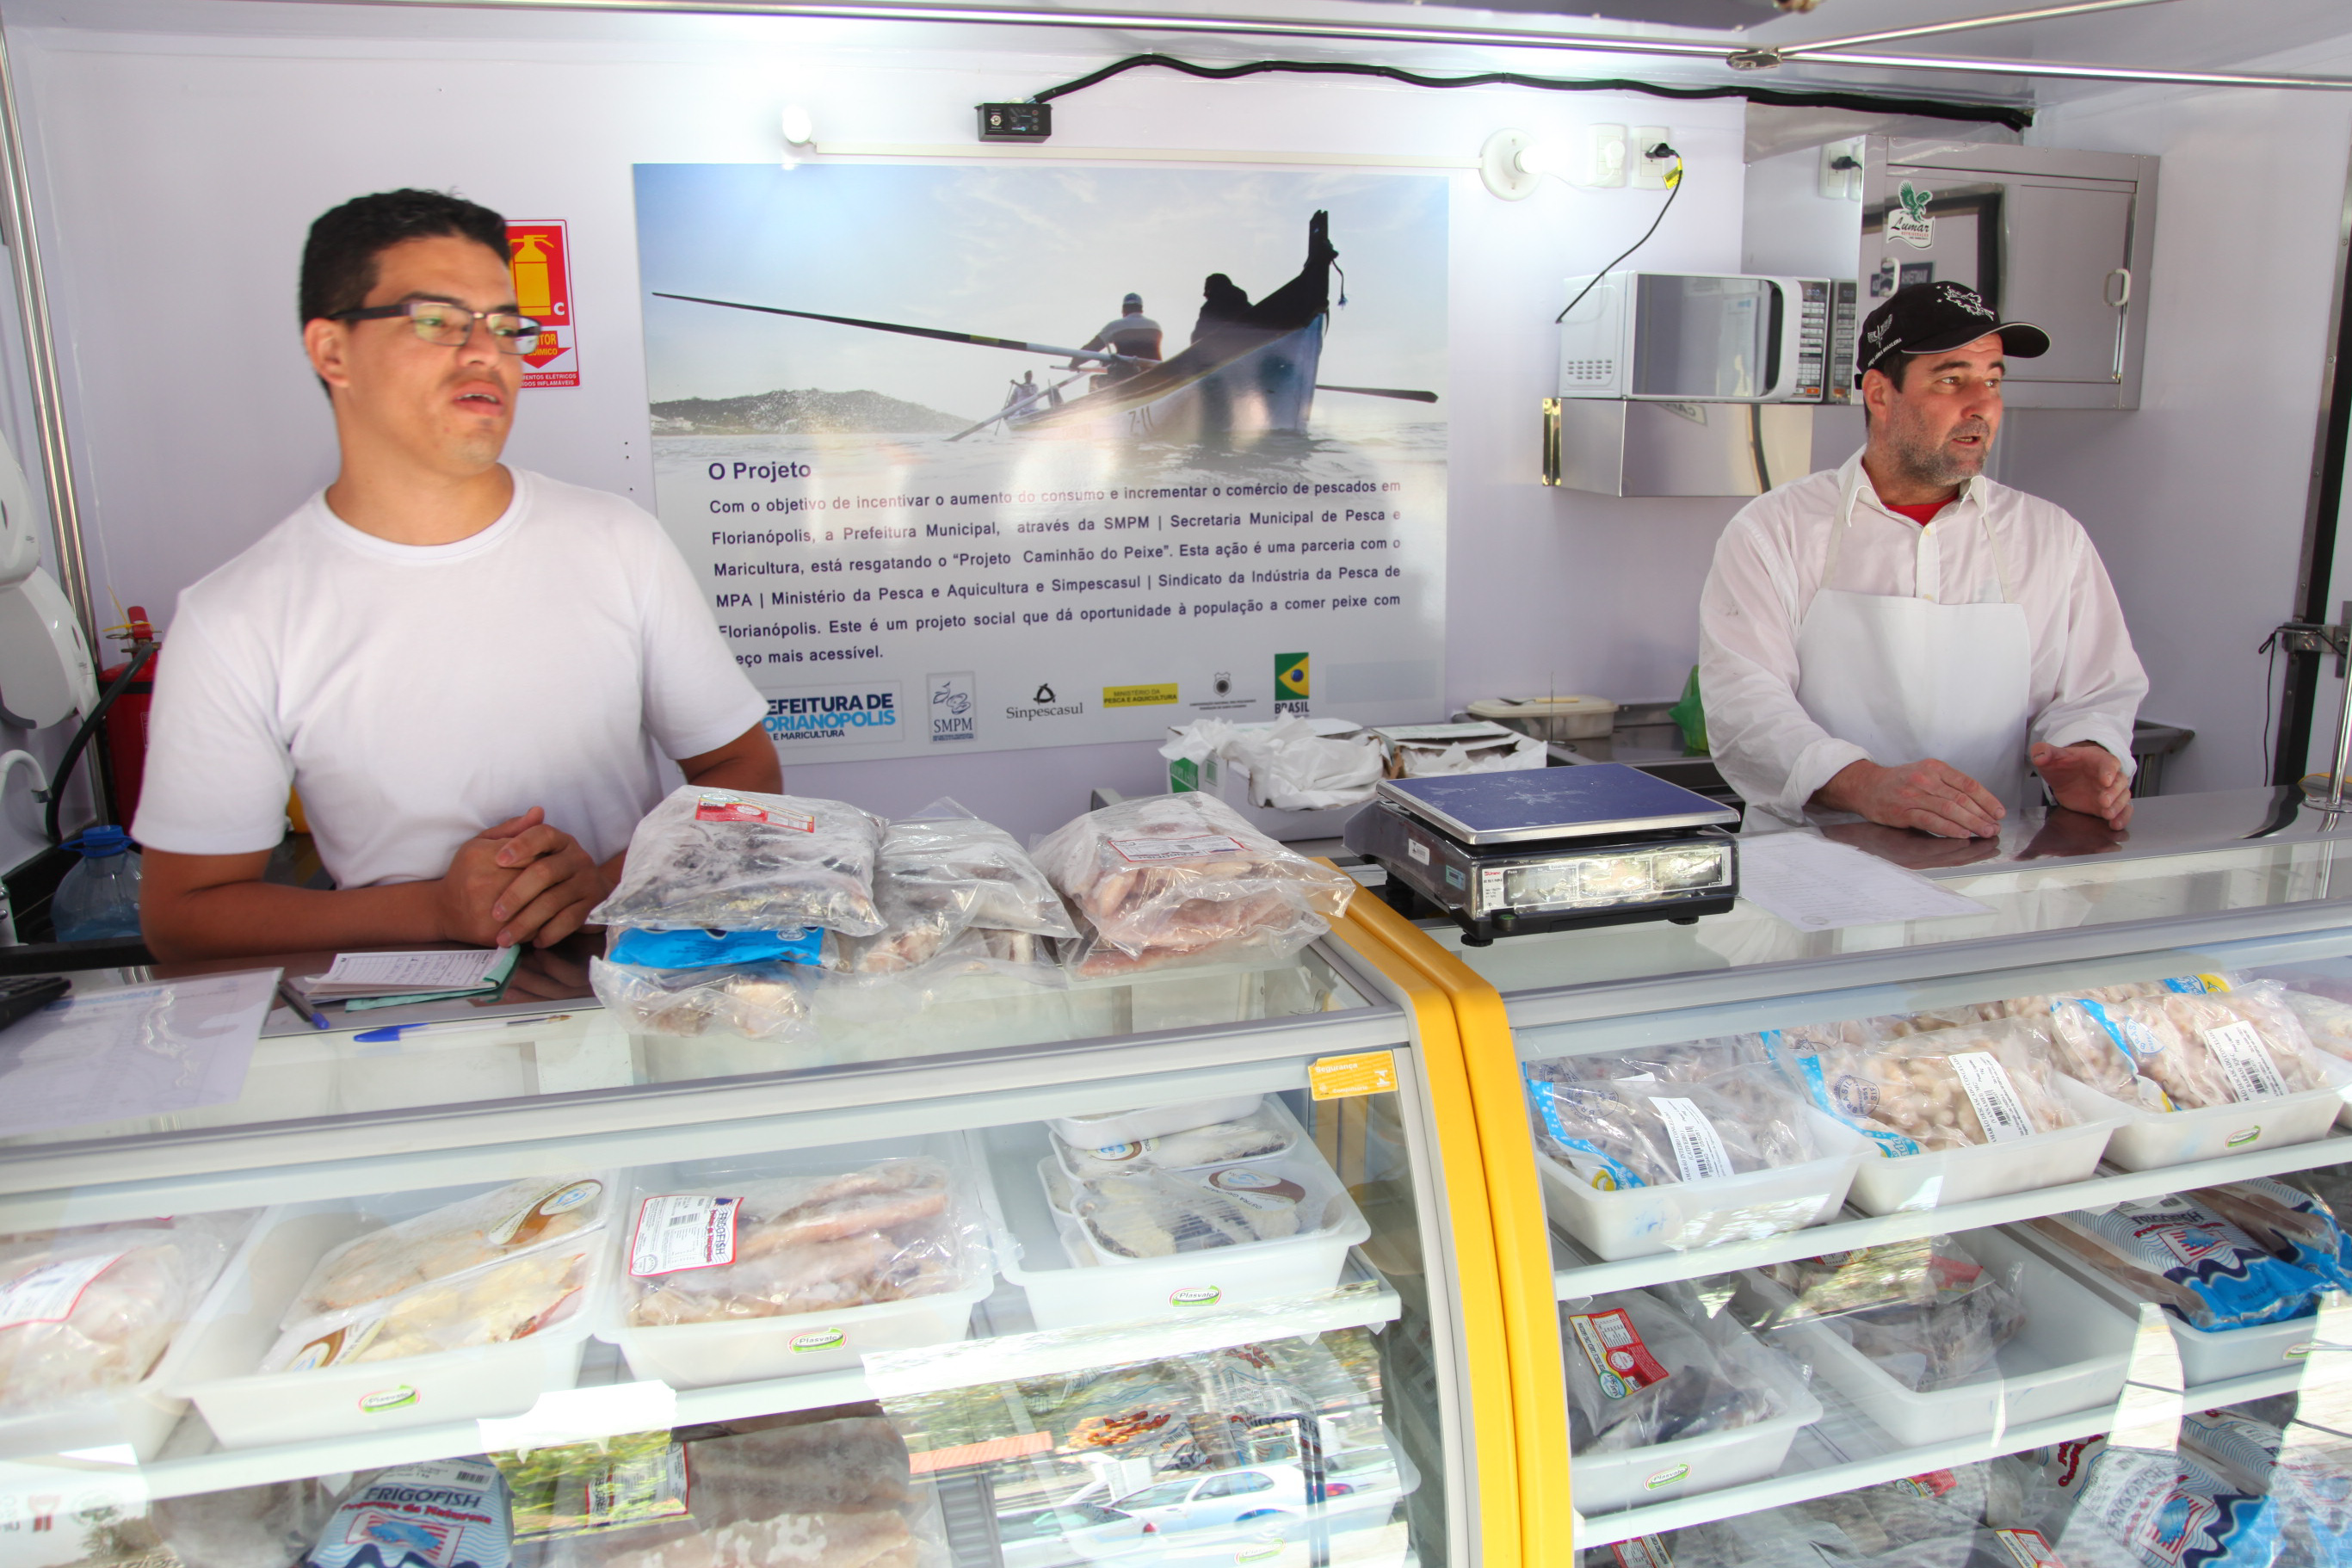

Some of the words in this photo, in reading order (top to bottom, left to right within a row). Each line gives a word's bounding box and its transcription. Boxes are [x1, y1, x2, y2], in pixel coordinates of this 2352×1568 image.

[1891, 216, 1929, 232] Lumar
[553, 302, 565, 316] C
[708, 462, 725, 481] O
[733, 460, 812, 484] Projeto
[709, 499, 744, 514] Com
[750, 502, 761, 513] o
[766, 496, 828, 515] objetivo
[832, 496, 851, 510] de
[856, 494, 930, 509] incentivar
[935, 496, 945, 506] o
[950, 491, 1012, 506] aumento
[1018, 492, 1035, 503] do
[1040, 491, 1105, 503] consumo
[1109, 490, 1119, 500] e
[1124, 486, 1207, 500] incrementar
[1213, 488, 1222, 498] o
[1225, 482, 1288, 497] comércio
[1293, 481, 1310, 495] de
[1314, 480, 1377, 497] pescados
[1381, 482, 1400, 492] em
[712, 528, 815, 546] Florianópolis,
[825, 530, 834, 541] a
[843, 526, 917, 540] Prefeitura
[926, 522, 1000, 539] Municipal,
[1017, 518, 1070, 534] através
[1077, 518, 1096, 531] da
[1104, 515, 1150, 530] SMPM
[1170, 513, 1241, 528] Secretaria
[1250, 510, 1313, 527] Municipal
[1321, 509, 1337, 522] de
[1345, 509, 1386, 522] Pesca
[1392, 511, 1399, 520] e
[713, 561, 805, 577] Maricultura,
[811, 558, 843, 573] está
[849, 554, 932, 574] resgatando
[938, 557, 948, 568] o
[1022, 547, 1095, 564] Caminhão
[1100, 546, 1118, 560] do
[1179, 544, 1210, 557] Esta
[1215, 541, 1248, 559] ação
[1253, 540, 1262, 554] é
[1268, 542, 1295, 553] uma
[1301, 538, 1355, 555] parceria
[1360, 540, 1387, 550] com
[1392, 539, 1400, 549] o
[716, 593, 753, 608] MPA
[771, 590, 846, 606] Ministério
[853, 588, 871, 602] da
[879, 587, 923, 601] Pesca
[930, 587, 940, 598] e
[947, 582, 1029, 600] Aquicultura
[1035, 583, 1045, 593] e
[1052, 575, 1140, 594] Simpescasul
[1158, 573, 1222, 587] Sindicato
[1228, 571, 1245, 584] da
[1251, 568, 1310, 583] Indústria
[1316, 567, 1332, 581] da
[1338, 566, 1379, 579] Pesca
[1385, 565, 1401, 577] de
[829, 620, 862, 633] Este
[869, 618, 879, 632] é
[886, 620, 908, 631] um
[916, 614, 966, 633] projeto
[973, 611, 1015, 627] social
[1022, 612, 1049, 627] que
[1055, 608, 1073, 621] dá
[1080, 603, 1171, 623] oportunidade
[1178, 602, 1187, 615] à
[1194, 599, 1263, 618] população
[1269, 601, 1278, 611] a
[1284, 599, 1326, 610] comer
[1332, 595, 1367, 611] peixe
[1374, 596, 1400, 607] com
[735, 653, 762, 669] eço
[768, 649, 804, 664] mais
[809, 645, 883, 662] acessível.
[767, 694, 863, 716] EFEITURA
[867, 692, 894, 710] DE
[1132, 693, 1177, 703] AQUICULTURA
[763, 709, 896, 732] ORIANÓPOLIS
[1006, 702, 1083, 720] Sinpescasul
[773, 732, 779, 741] E
[781, 730, 845, 740] MARICULTURA
[934, 717, 972, 734] SMPM
[1315, 1062, 1359, 1074] Segurança
[1953, 1053, 1972, 1087] CONGELADO
[2225, 1057, 2244, 1090] DESCASCADO
[1968, 1084, 1988, 1120] DESCASCADO
[1676, 1137, 1687, 1160] INTEIRO
[1683, 1157, 1694, 1182] AMARÃO
[714, 1212, 727, 1255] FRIGOFISH
[1608, 1383, 1620, 1398] Mar
[364, 1487, 482, 1508] FRIGOFISH
